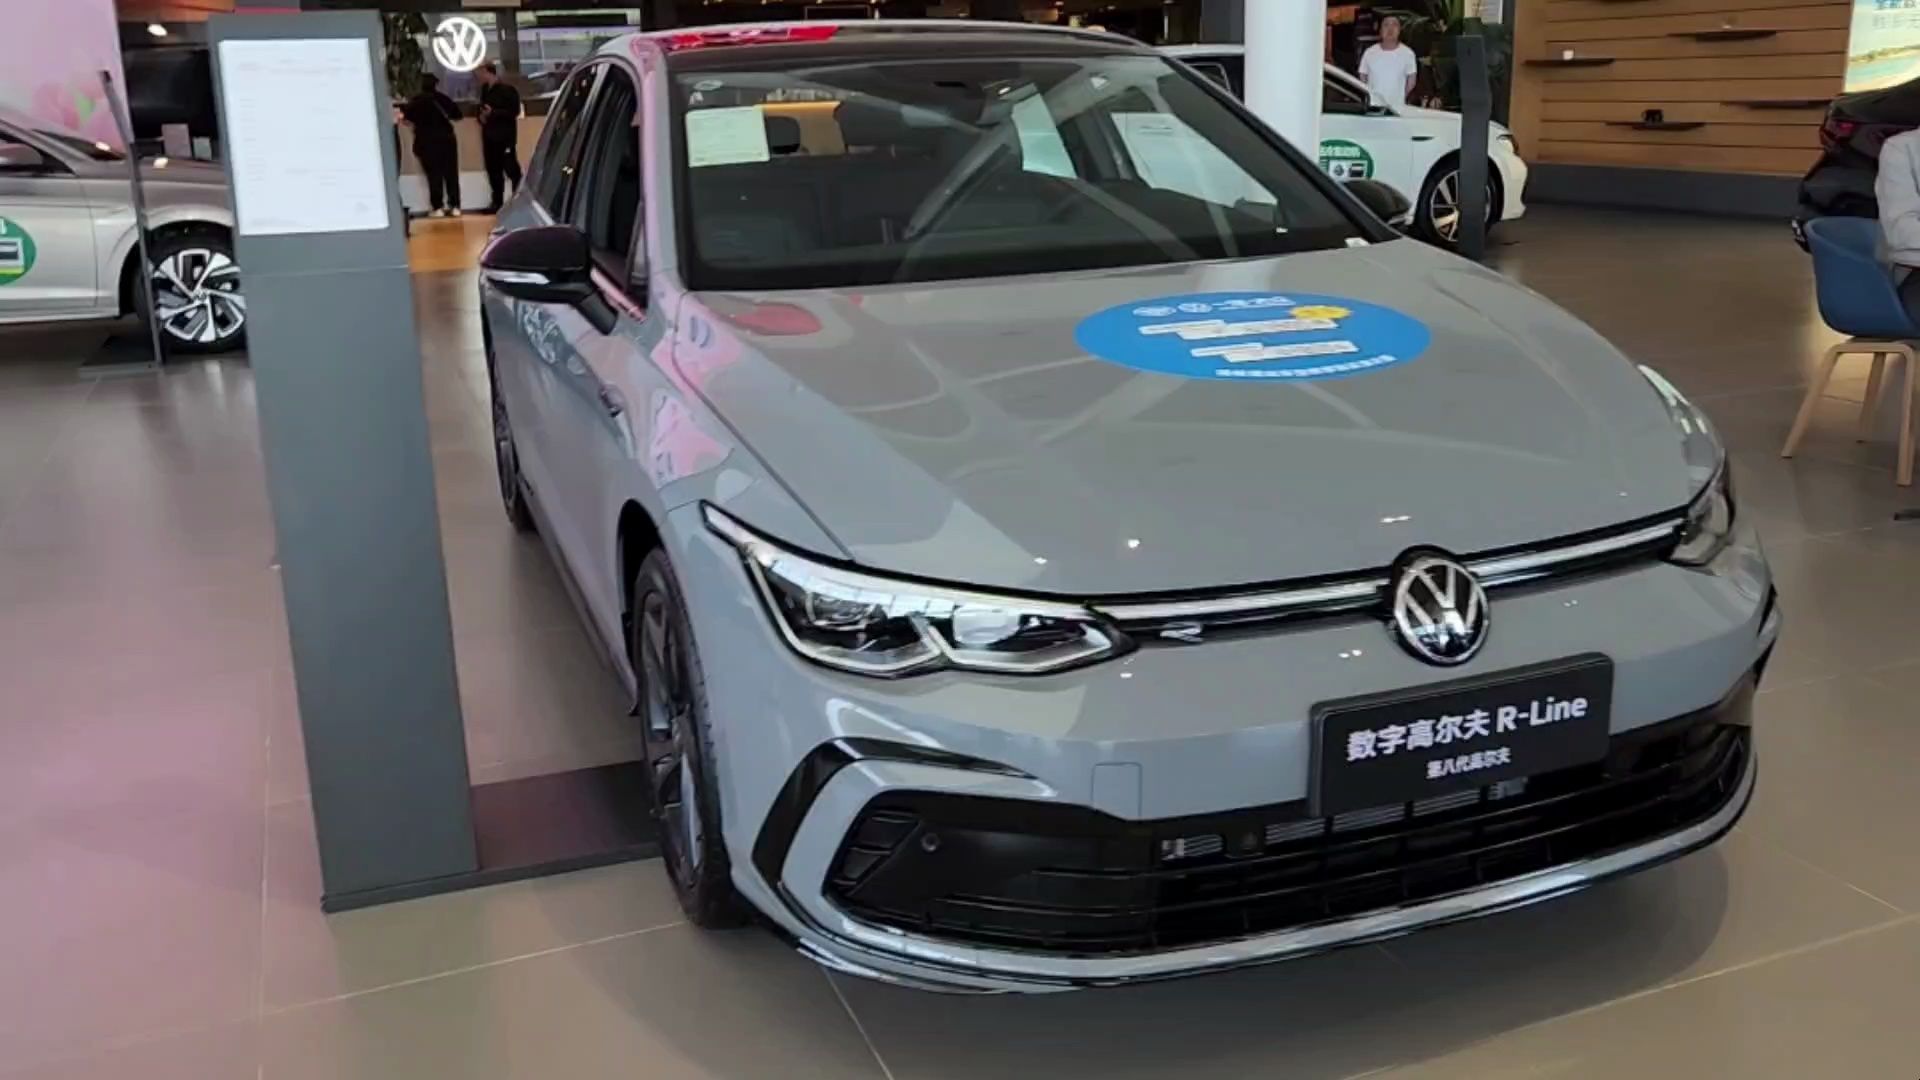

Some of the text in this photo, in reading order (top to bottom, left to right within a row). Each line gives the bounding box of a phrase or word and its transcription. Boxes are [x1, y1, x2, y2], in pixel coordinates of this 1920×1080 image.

[1347, 697, 1588, 761] 数字高尔夫 R-Line
